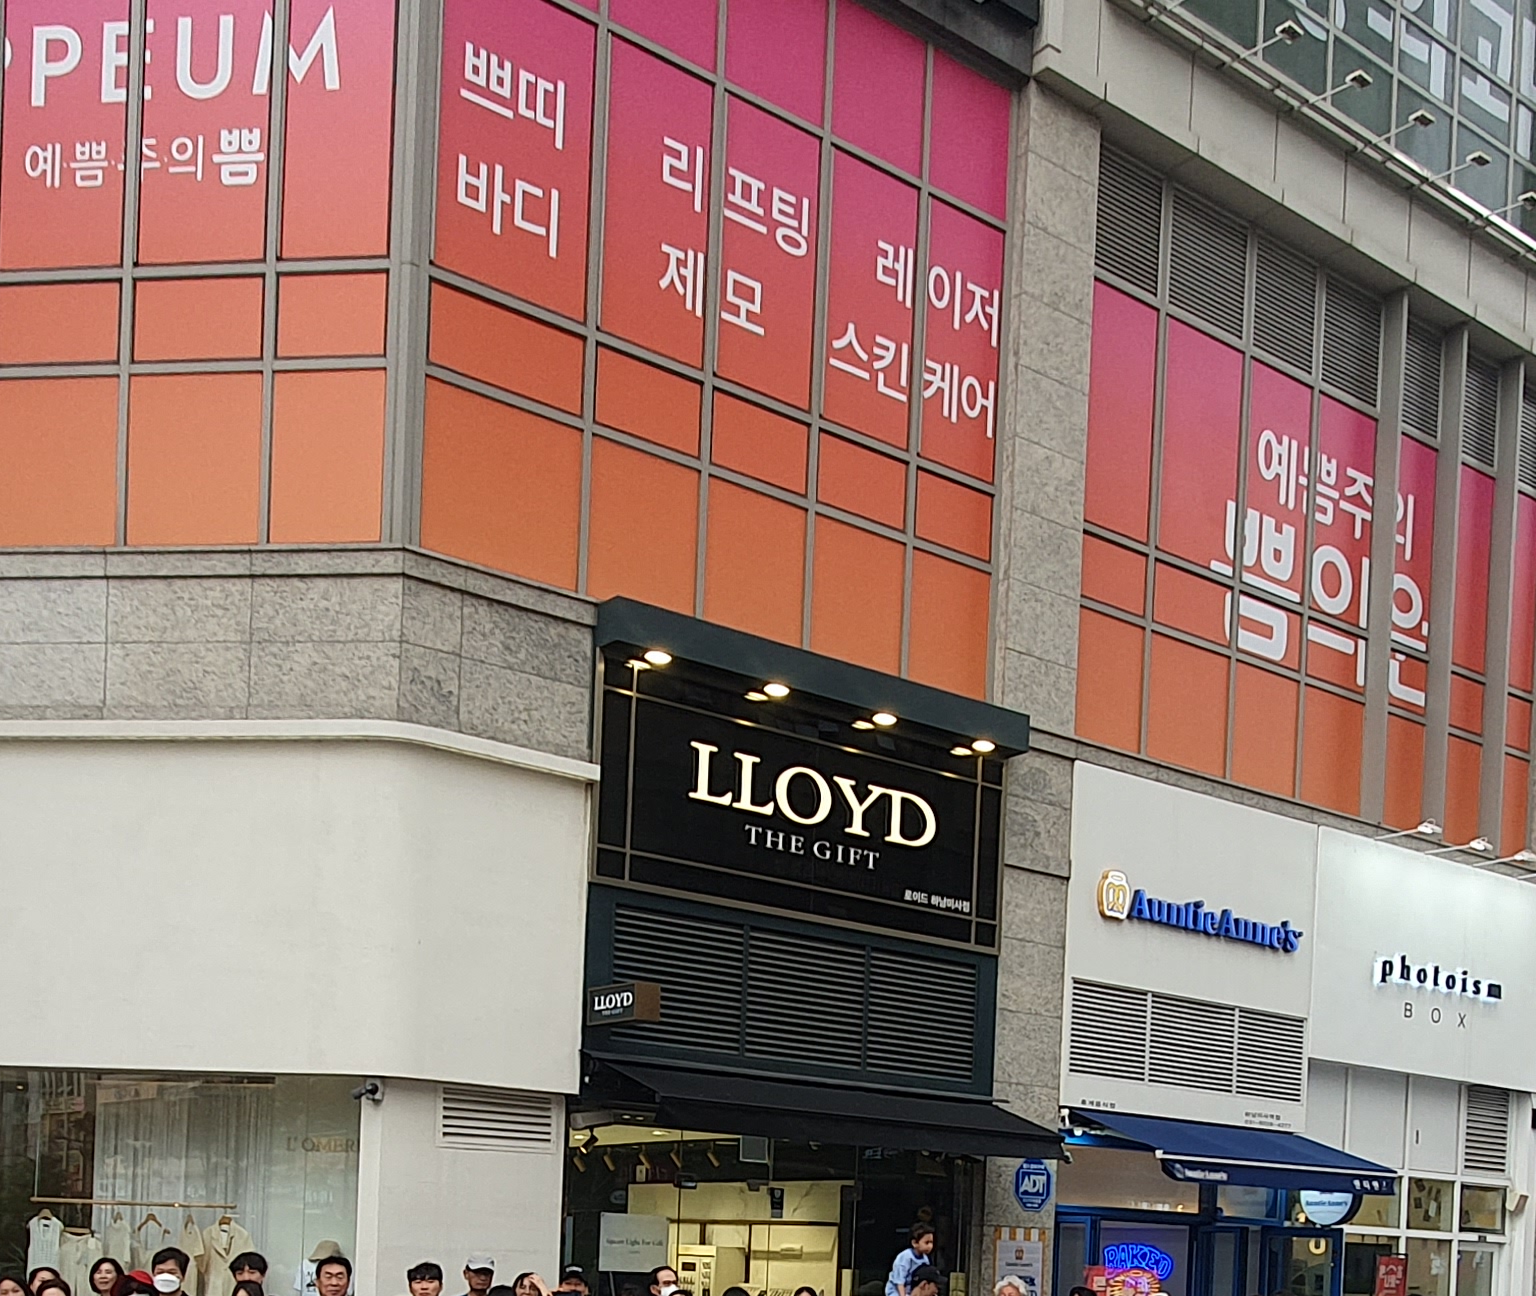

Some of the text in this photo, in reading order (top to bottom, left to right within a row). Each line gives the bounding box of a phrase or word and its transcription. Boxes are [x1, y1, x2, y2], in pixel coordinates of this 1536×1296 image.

[459, 41, 565, 150] 쁘띠
[456, 154, 559, 258] 바디
[662, 136, 809, 257] 리프팅
[659, 242, 764, 336] 제모
[876, 239, 999, 348] 레이저
[830, 321, 995, 439] 스킨케어
[688, 740, 936, 847] LLOYD
[745, 824, 880, 871] THE GIFT
[594, 992, 632, 1010] LLOYD
[1380, 954, 1502, 1000] photoism
[1404, 1001, 1467, 1030] BOX
[1019, 1172, 1046, 1195] ADT
[1104, 1244, 1173, 1279] BAKED
